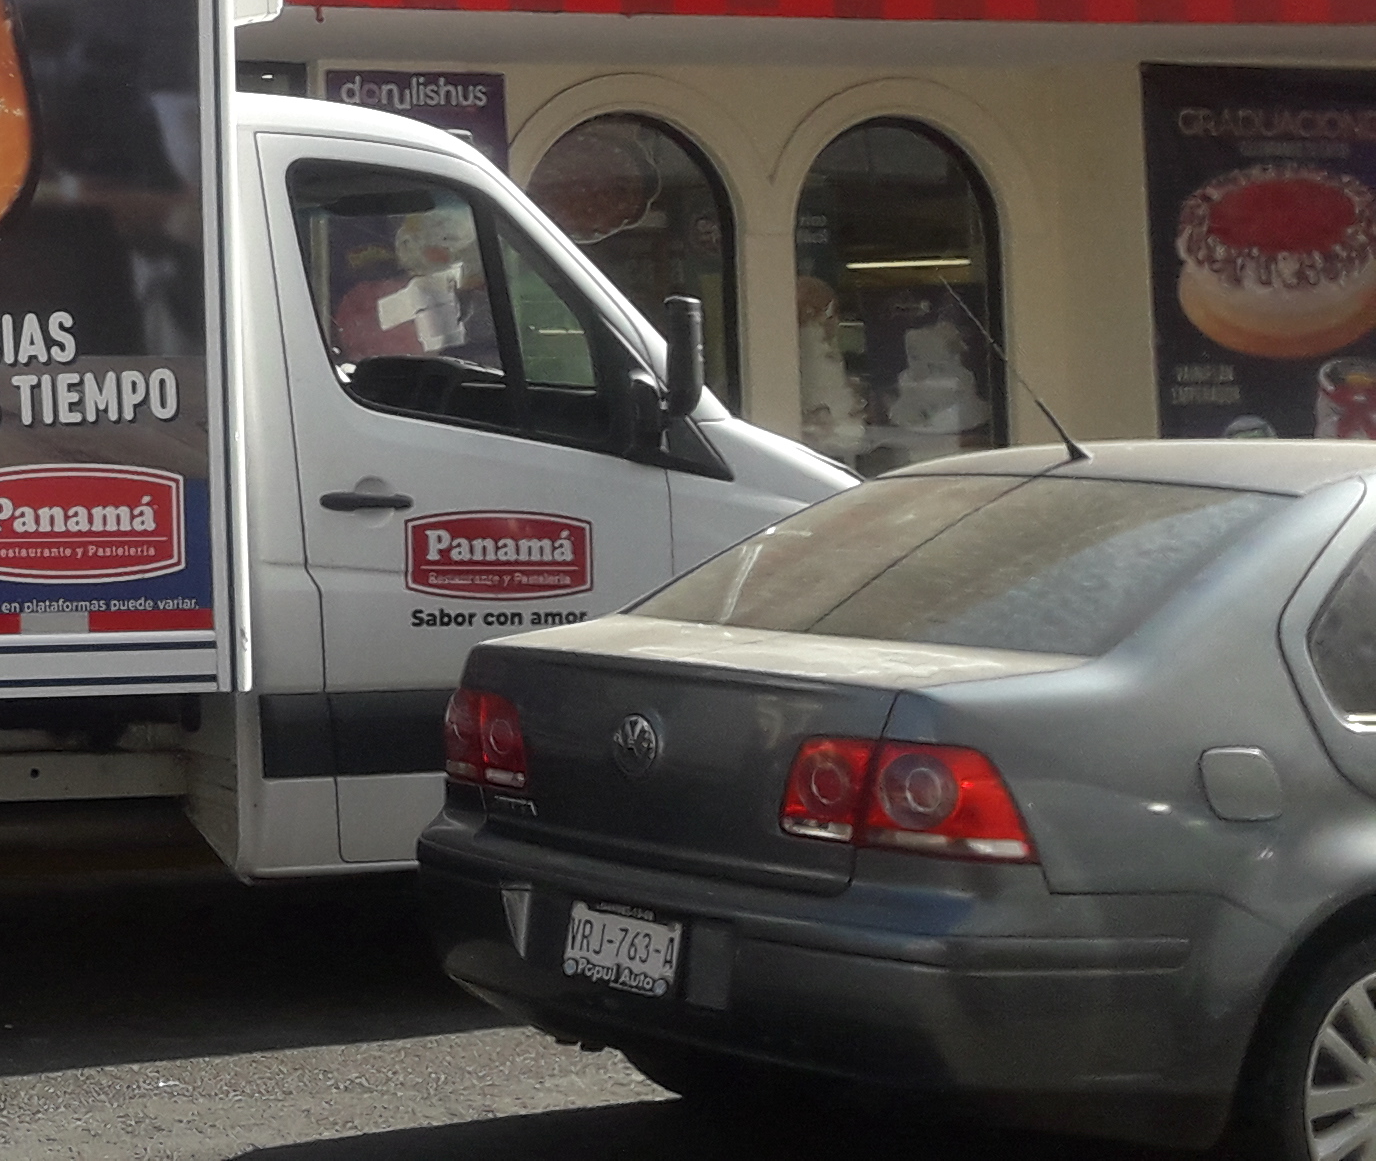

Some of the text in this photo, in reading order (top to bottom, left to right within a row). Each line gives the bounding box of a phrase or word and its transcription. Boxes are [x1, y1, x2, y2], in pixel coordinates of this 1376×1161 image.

[12, 368, 179, 426] TIEMPO
[75, 547, 84, 559] y
[424, 529, 575, 562] Panamá
[4, 602, 20, 614] en
[23, 598, 107, 614] plataformas
[110, 597, 153, 612] puede
[410, 607, 589, 627] Sabor con amor
[621, 969, 654, 989] Auto
